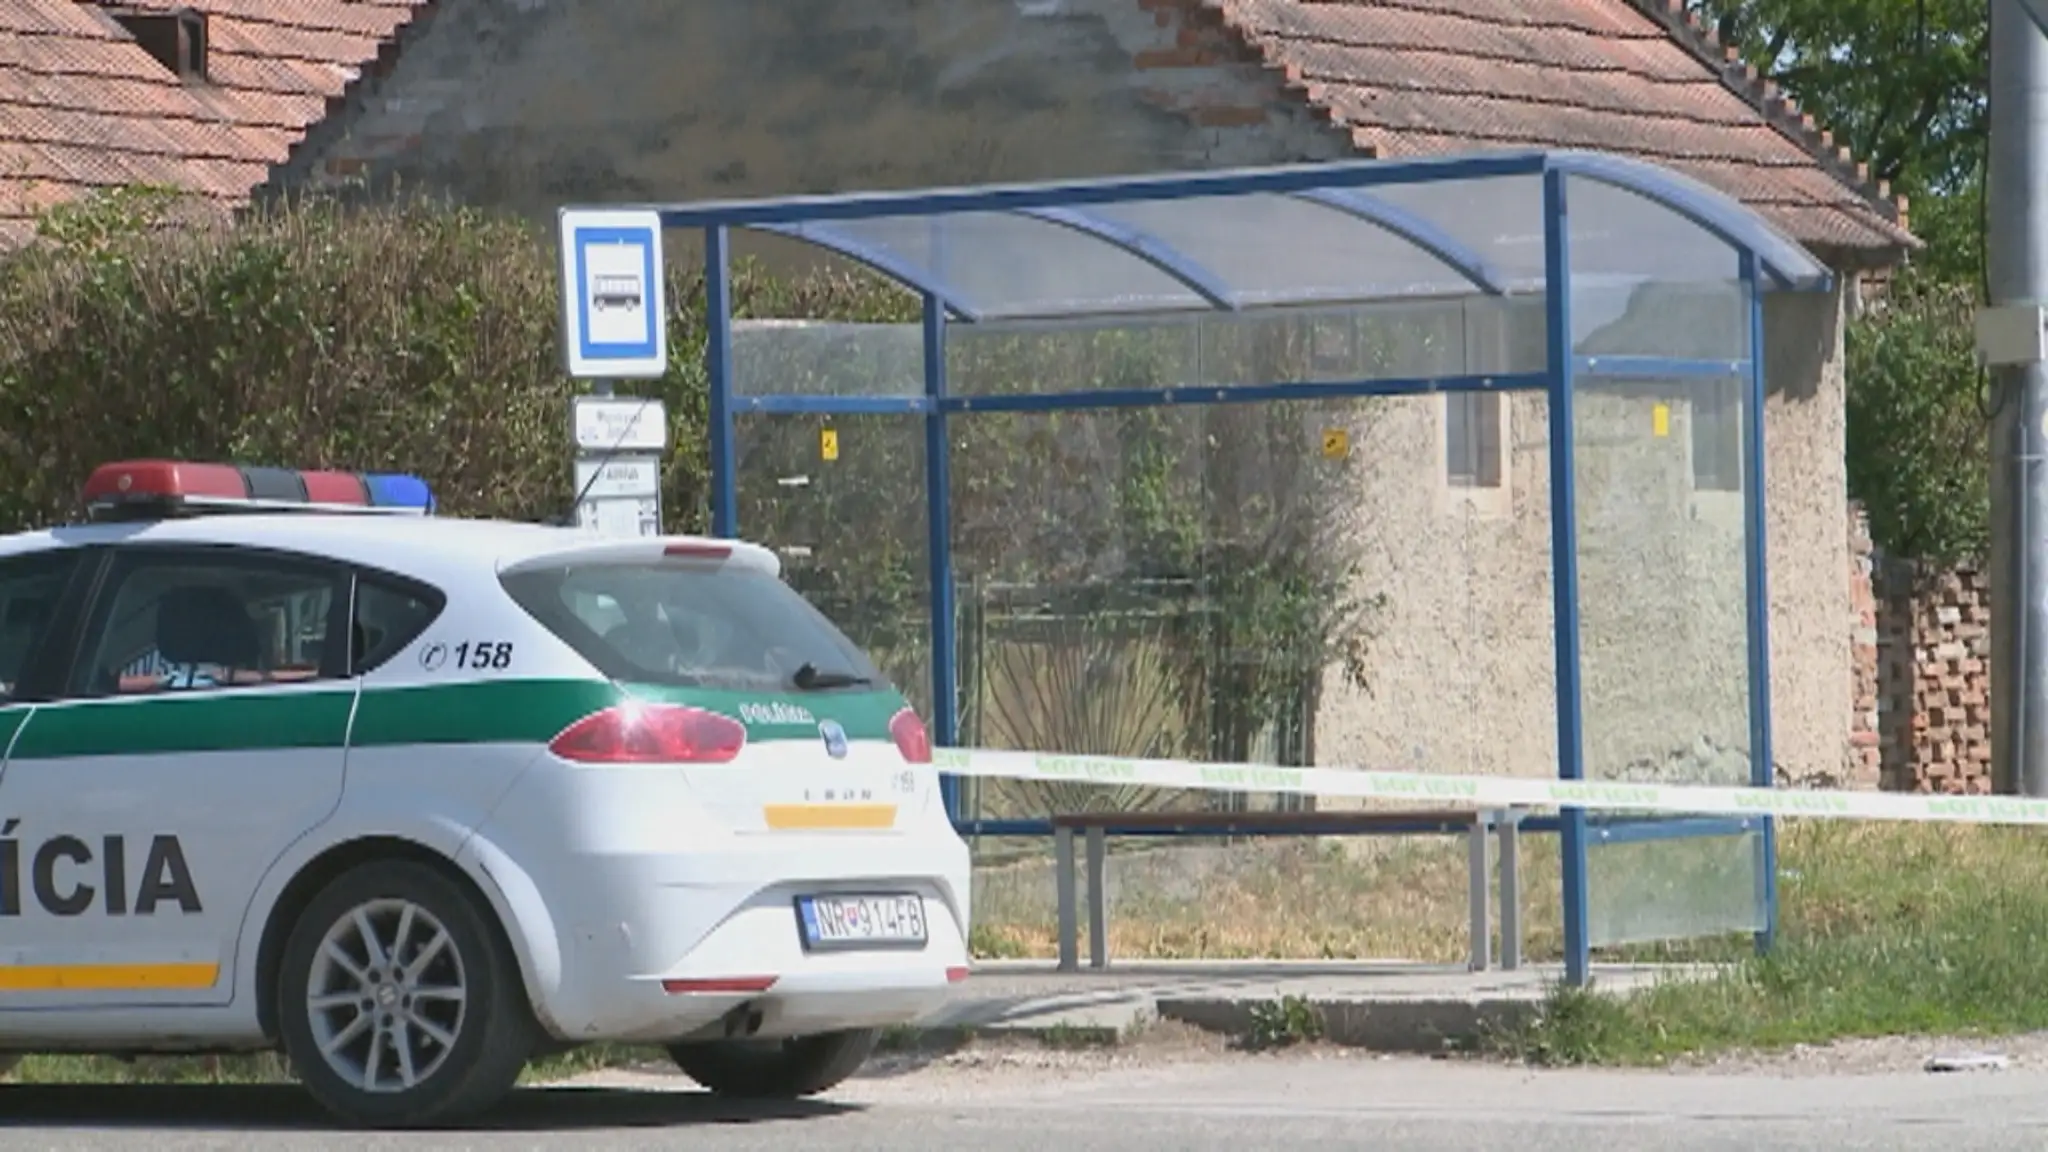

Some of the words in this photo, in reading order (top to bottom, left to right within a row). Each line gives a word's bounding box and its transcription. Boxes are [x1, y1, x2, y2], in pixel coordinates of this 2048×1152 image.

[456, 642, 513, 669] 158
[0, 818, 203, 916] ÍCIA
[817, 899, 849, 936] NR
